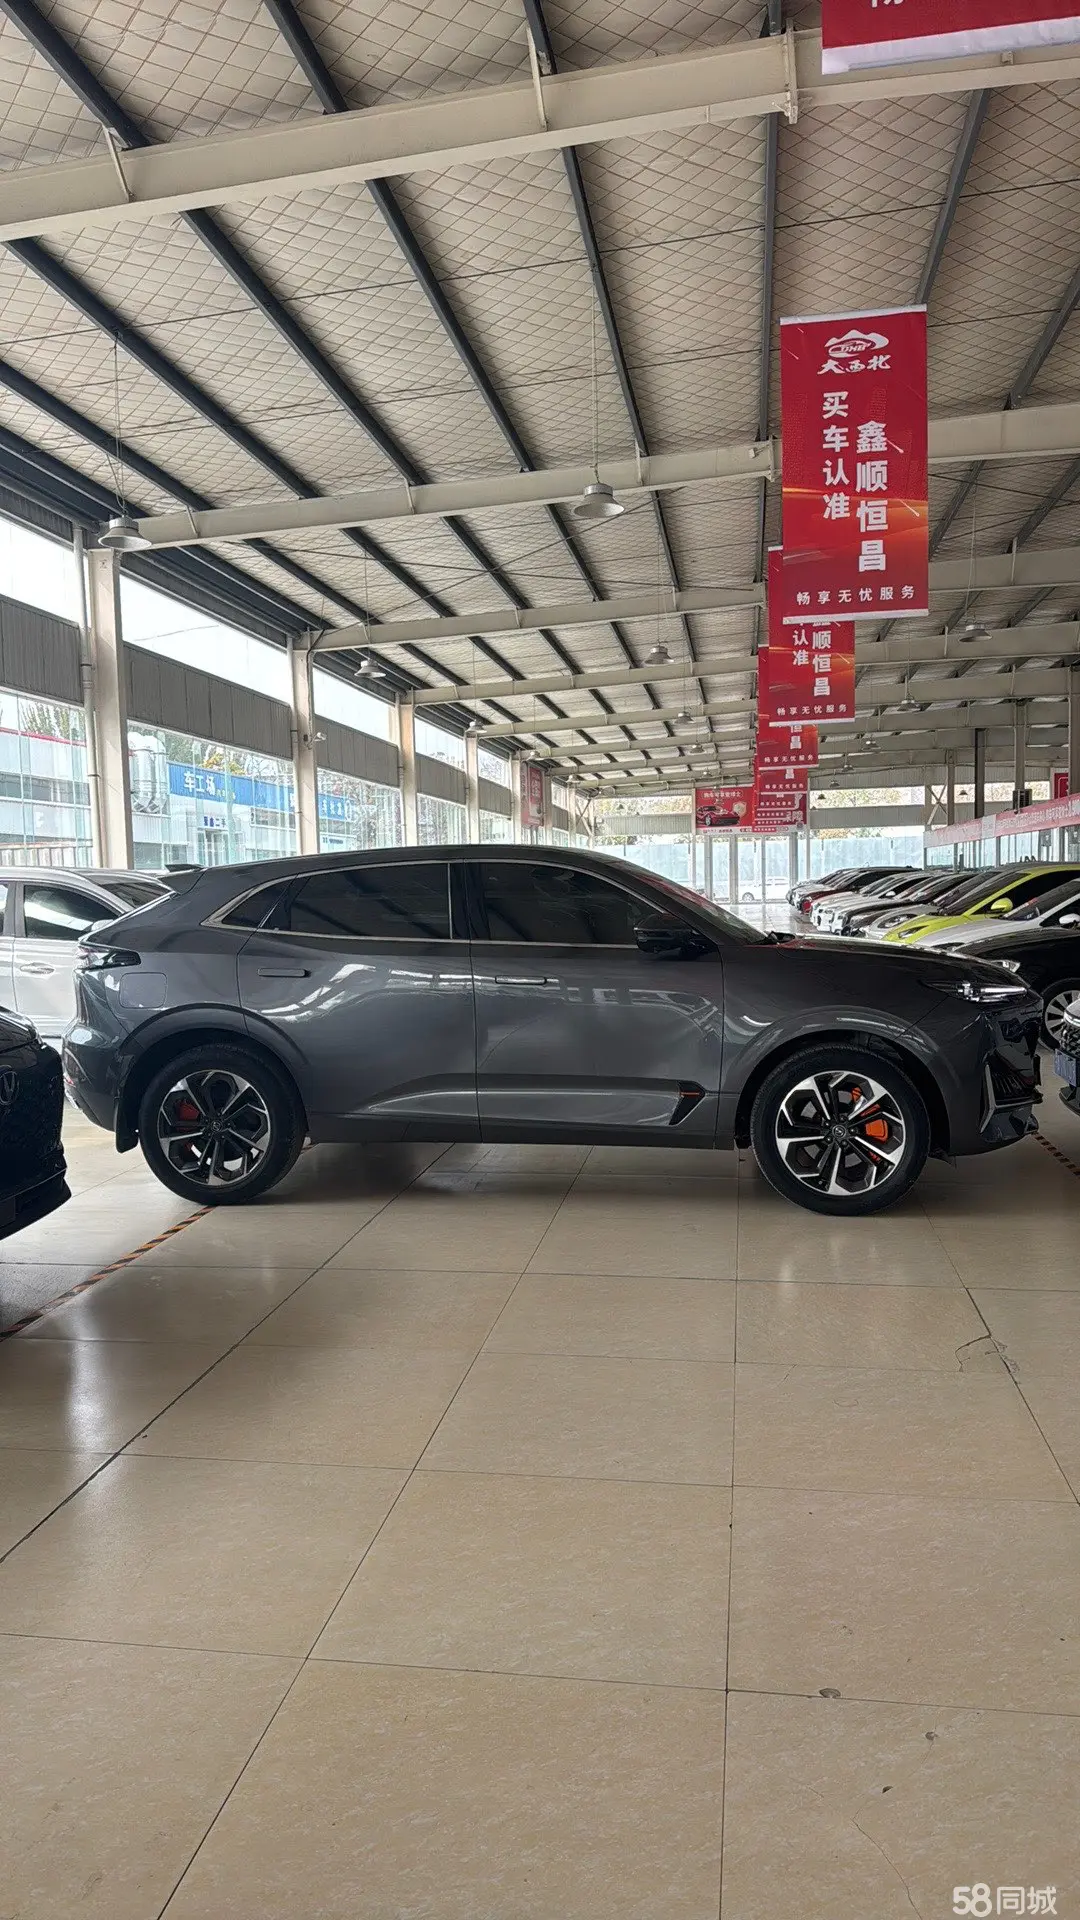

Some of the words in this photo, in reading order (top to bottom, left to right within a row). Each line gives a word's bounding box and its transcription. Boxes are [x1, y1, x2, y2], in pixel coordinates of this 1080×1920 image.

[817, 354, 892, 375] 大西北
[822, 391, 850, 520] 买车认准
[856, 420, 888, 572] 鑫顺恒昌
[796, 585, 915, 606] 畅享无忧服务
[792, 624, 809, 666] 认准
[812, 621, 832, 696] 顺恒昌
[777, 704, 847, 716] 畅享无忧服务
